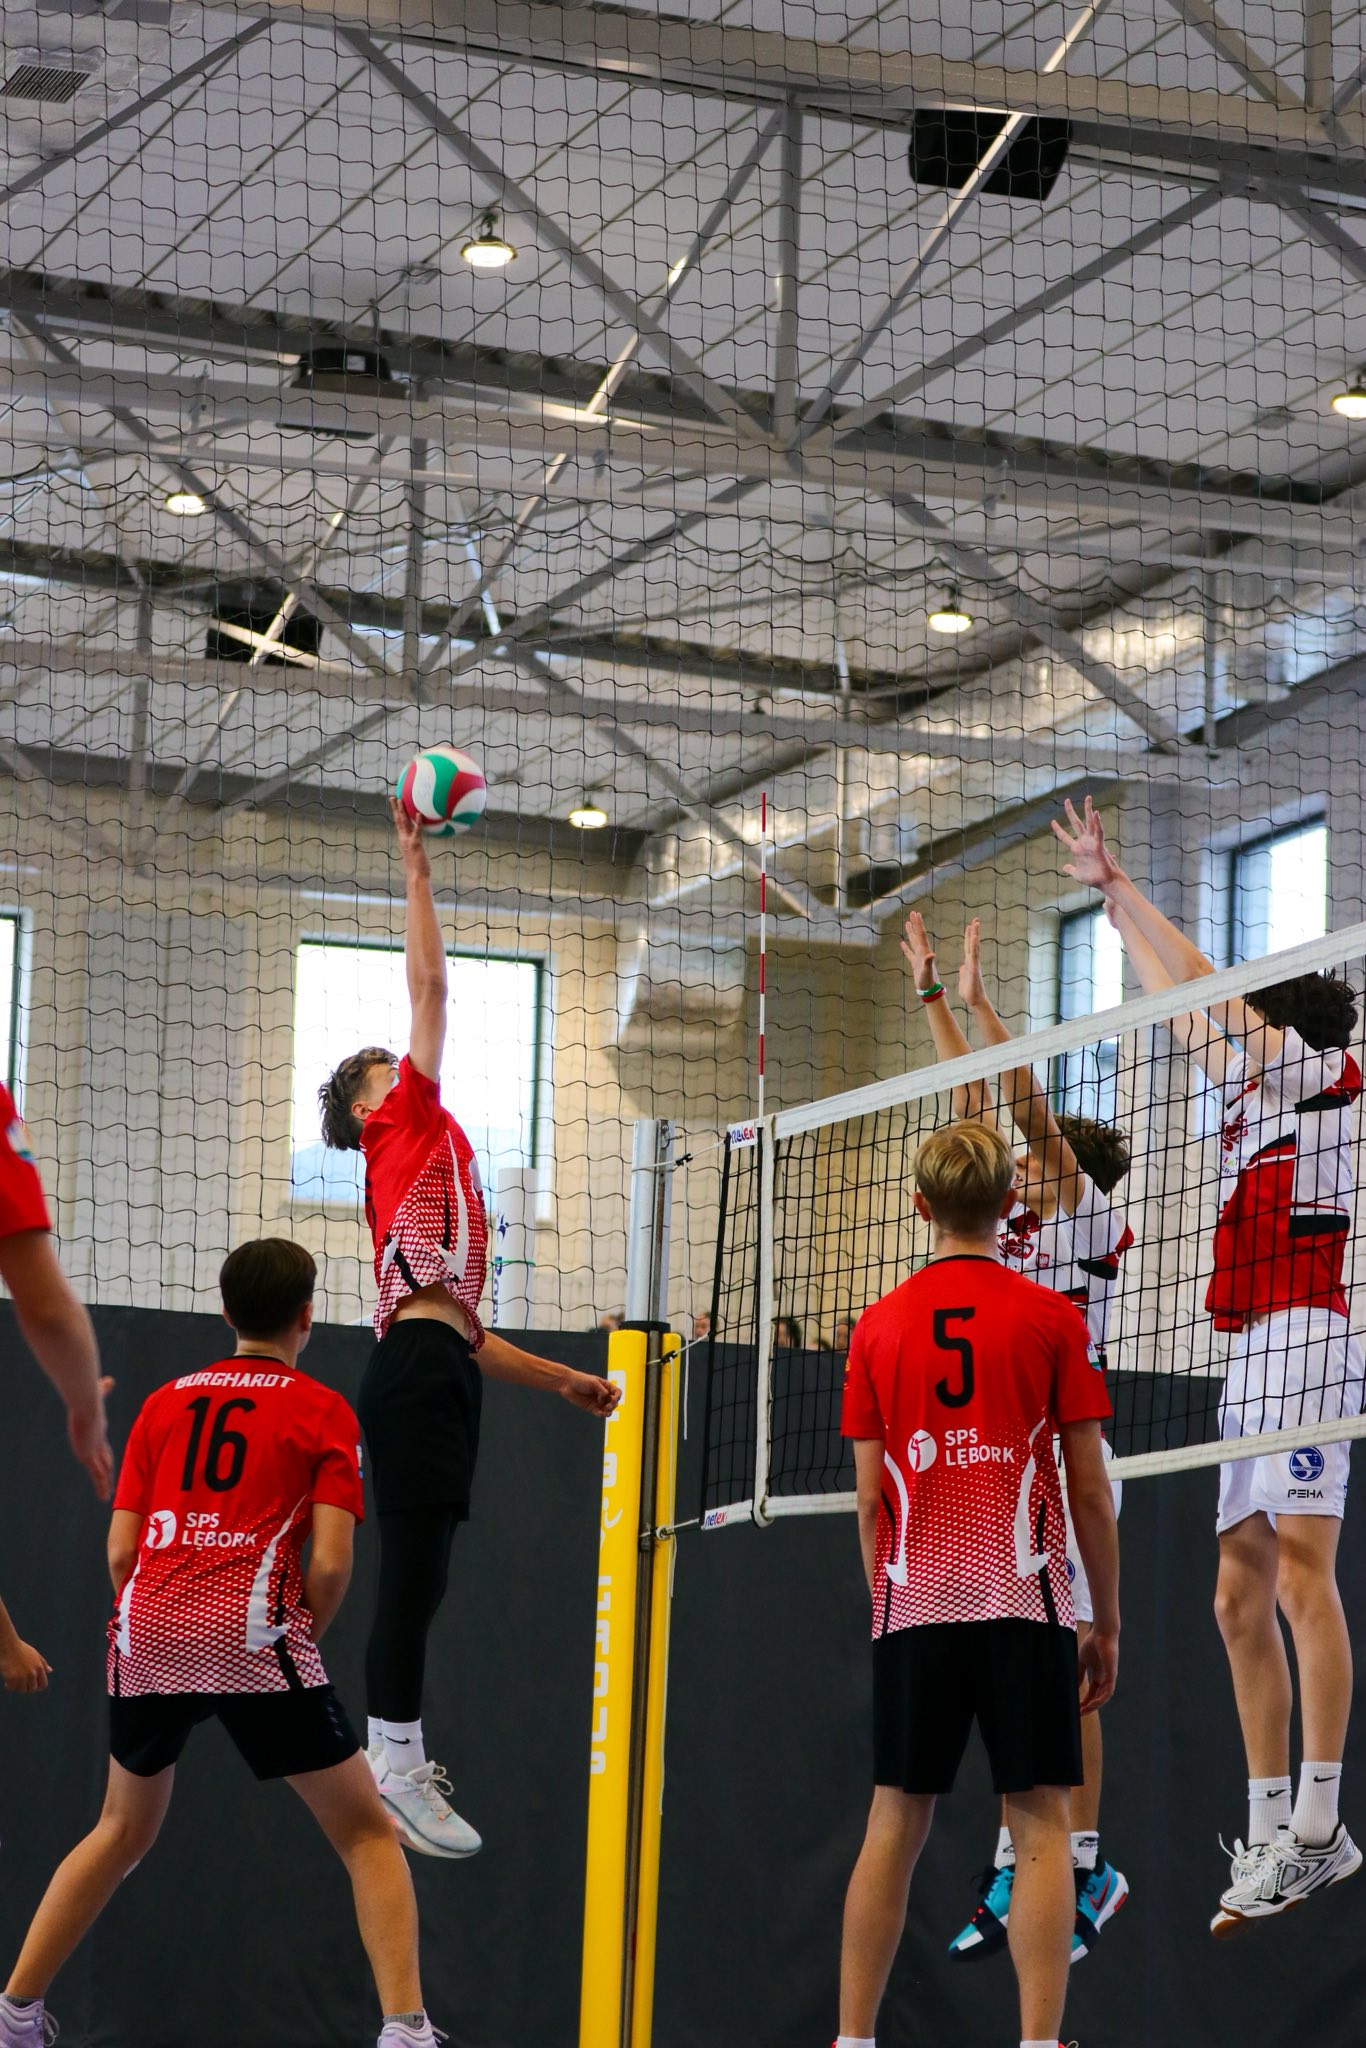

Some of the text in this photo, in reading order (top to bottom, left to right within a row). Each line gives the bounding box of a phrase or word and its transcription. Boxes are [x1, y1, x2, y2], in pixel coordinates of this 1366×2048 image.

[933, 1306, 976, 1409] 5
[174, 1372, 296, 1390] BURGHARDT
[180, 1396, 256, 1492] 16
[944, 1427, 978, 1447] SPS
[1287, 1489, 1324, 1499] PEHA
[184, 1511, 220, 1529] SPS
[705, 1512, 727, 1528] netex
